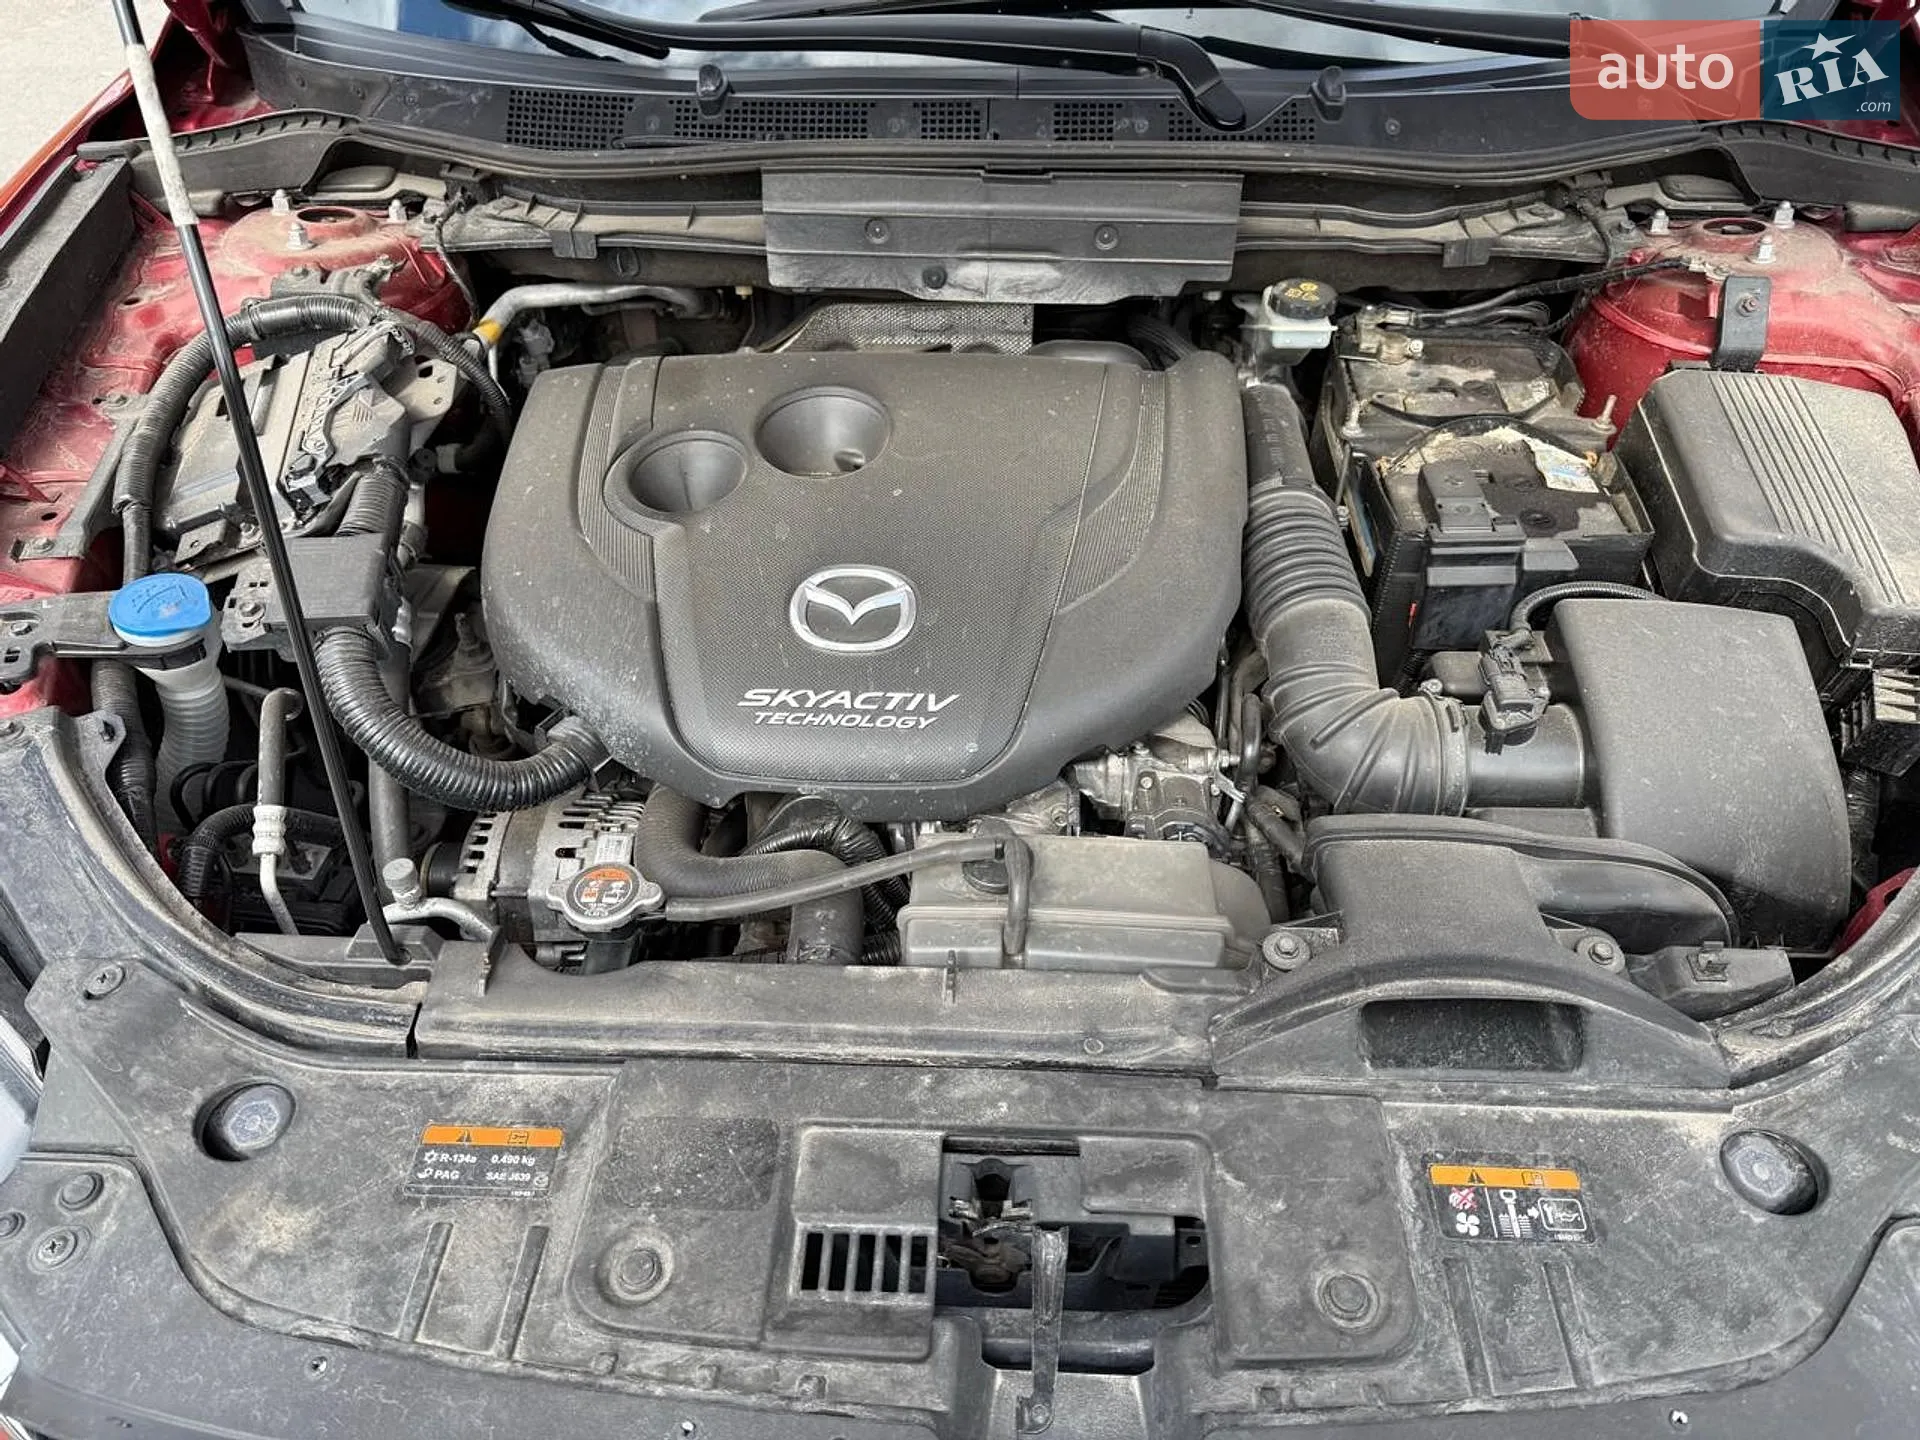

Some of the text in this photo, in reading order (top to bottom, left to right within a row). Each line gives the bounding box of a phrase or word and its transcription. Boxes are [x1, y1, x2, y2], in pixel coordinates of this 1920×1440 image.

[736, 688, 960, 712] SKYACTIV
[754, 711, 938, 729] TECHNOLOGY
[439, 1152, 477, 1164] R-134a
[521, 1154, 536, 1167] kg
[433, 1169, 460, 1180] PAG
[485, 1172, 507, 1182] SAE
